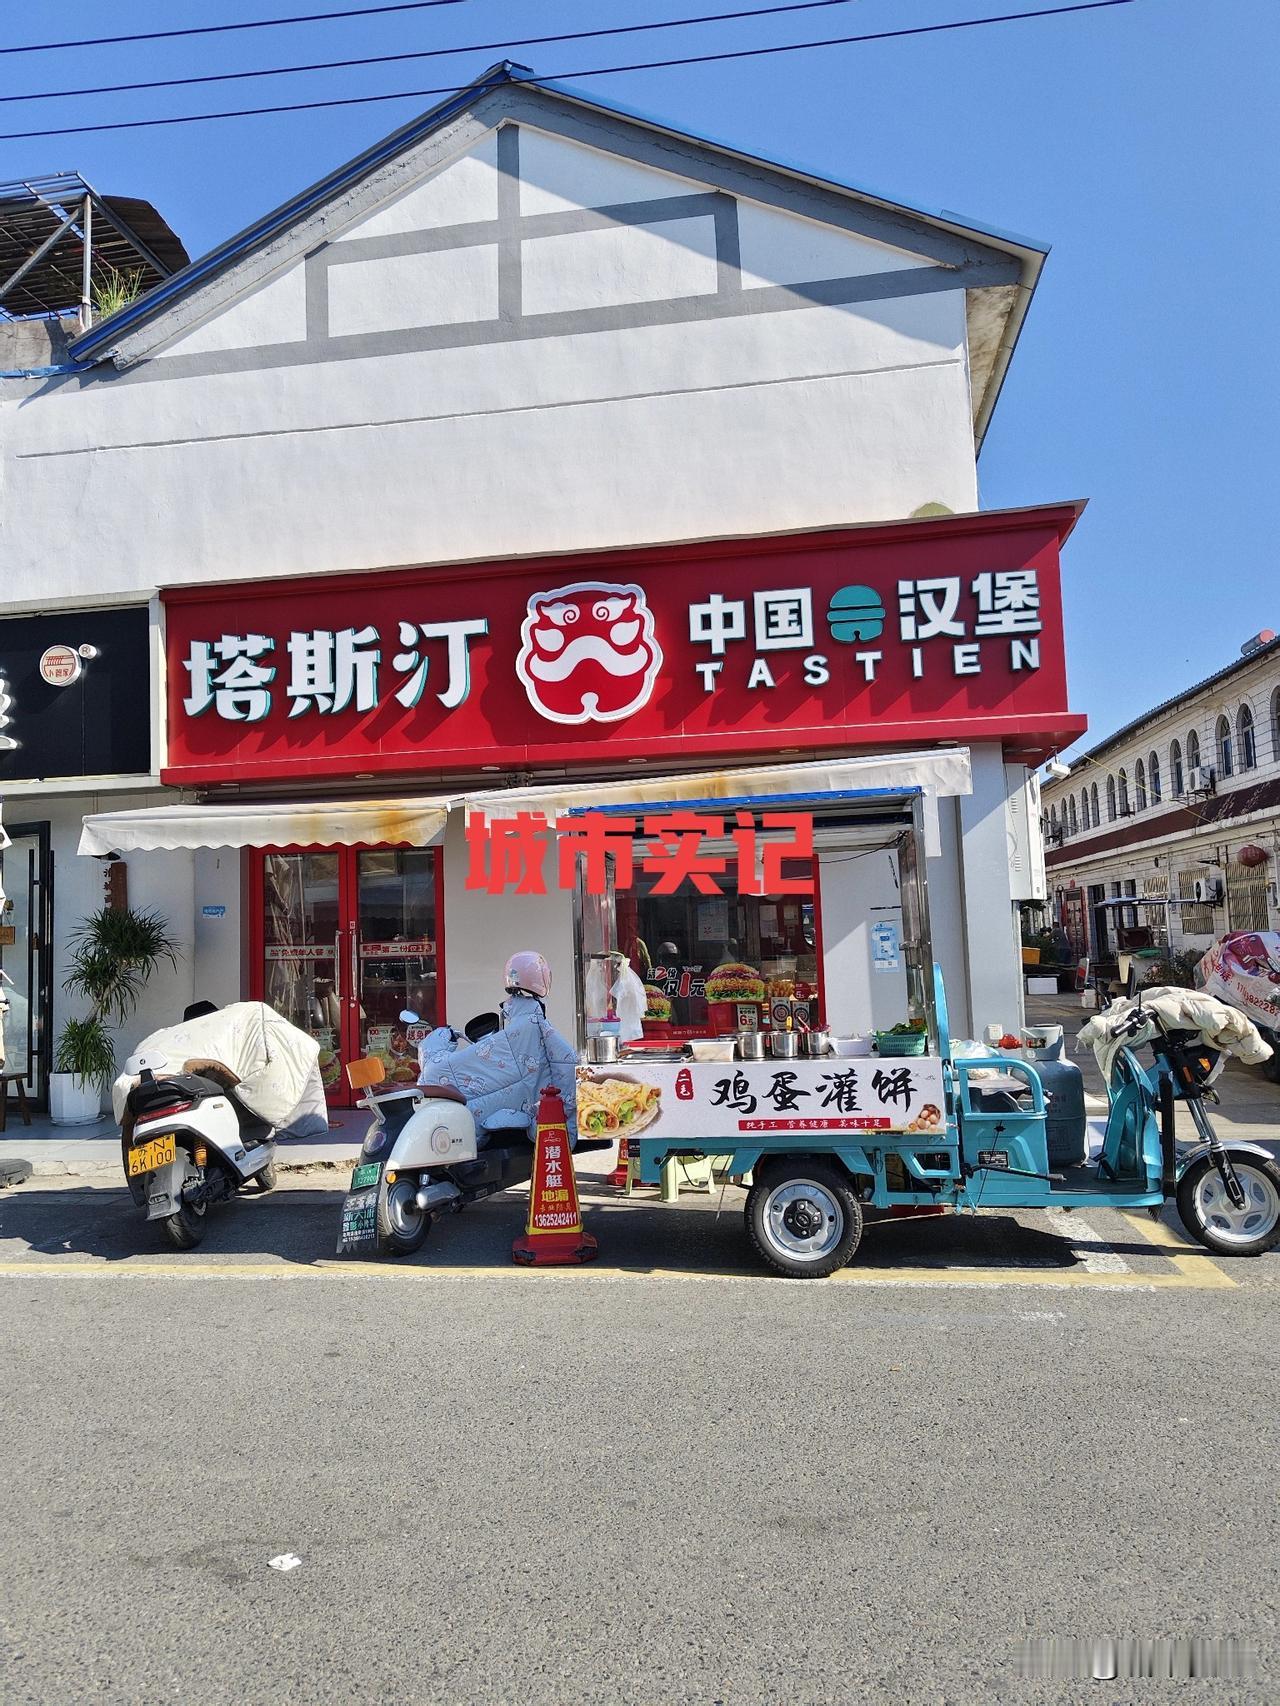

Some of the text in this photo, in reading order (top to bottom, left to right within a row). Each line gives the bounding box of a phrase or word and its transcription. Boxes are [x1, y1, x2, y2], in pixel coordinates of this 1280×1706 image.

[689, 569, 1042, 655] 中国 汉堡
[182, 617, 489, 722] 塔斯汀
[695, 638, 1041, 692] TASTIEN
[647, 966, 677, 981] 第2份
[663, 973, 705, 998] 仅1元
[678, 1073, 691, 1096] 二毛
[709, 1067, 918, 1115] 鸡蛋灌饼
[746, 1118, 882, 1130] 纯手工 营养健康 美味十足
[131, 1149, 173, 1174] 6K100
[544, 1146, 563, 1188] 潜水艇
[541, 1189, 569, 1203] 地漏
[534, 1211, 577, 1227] 13625242411
